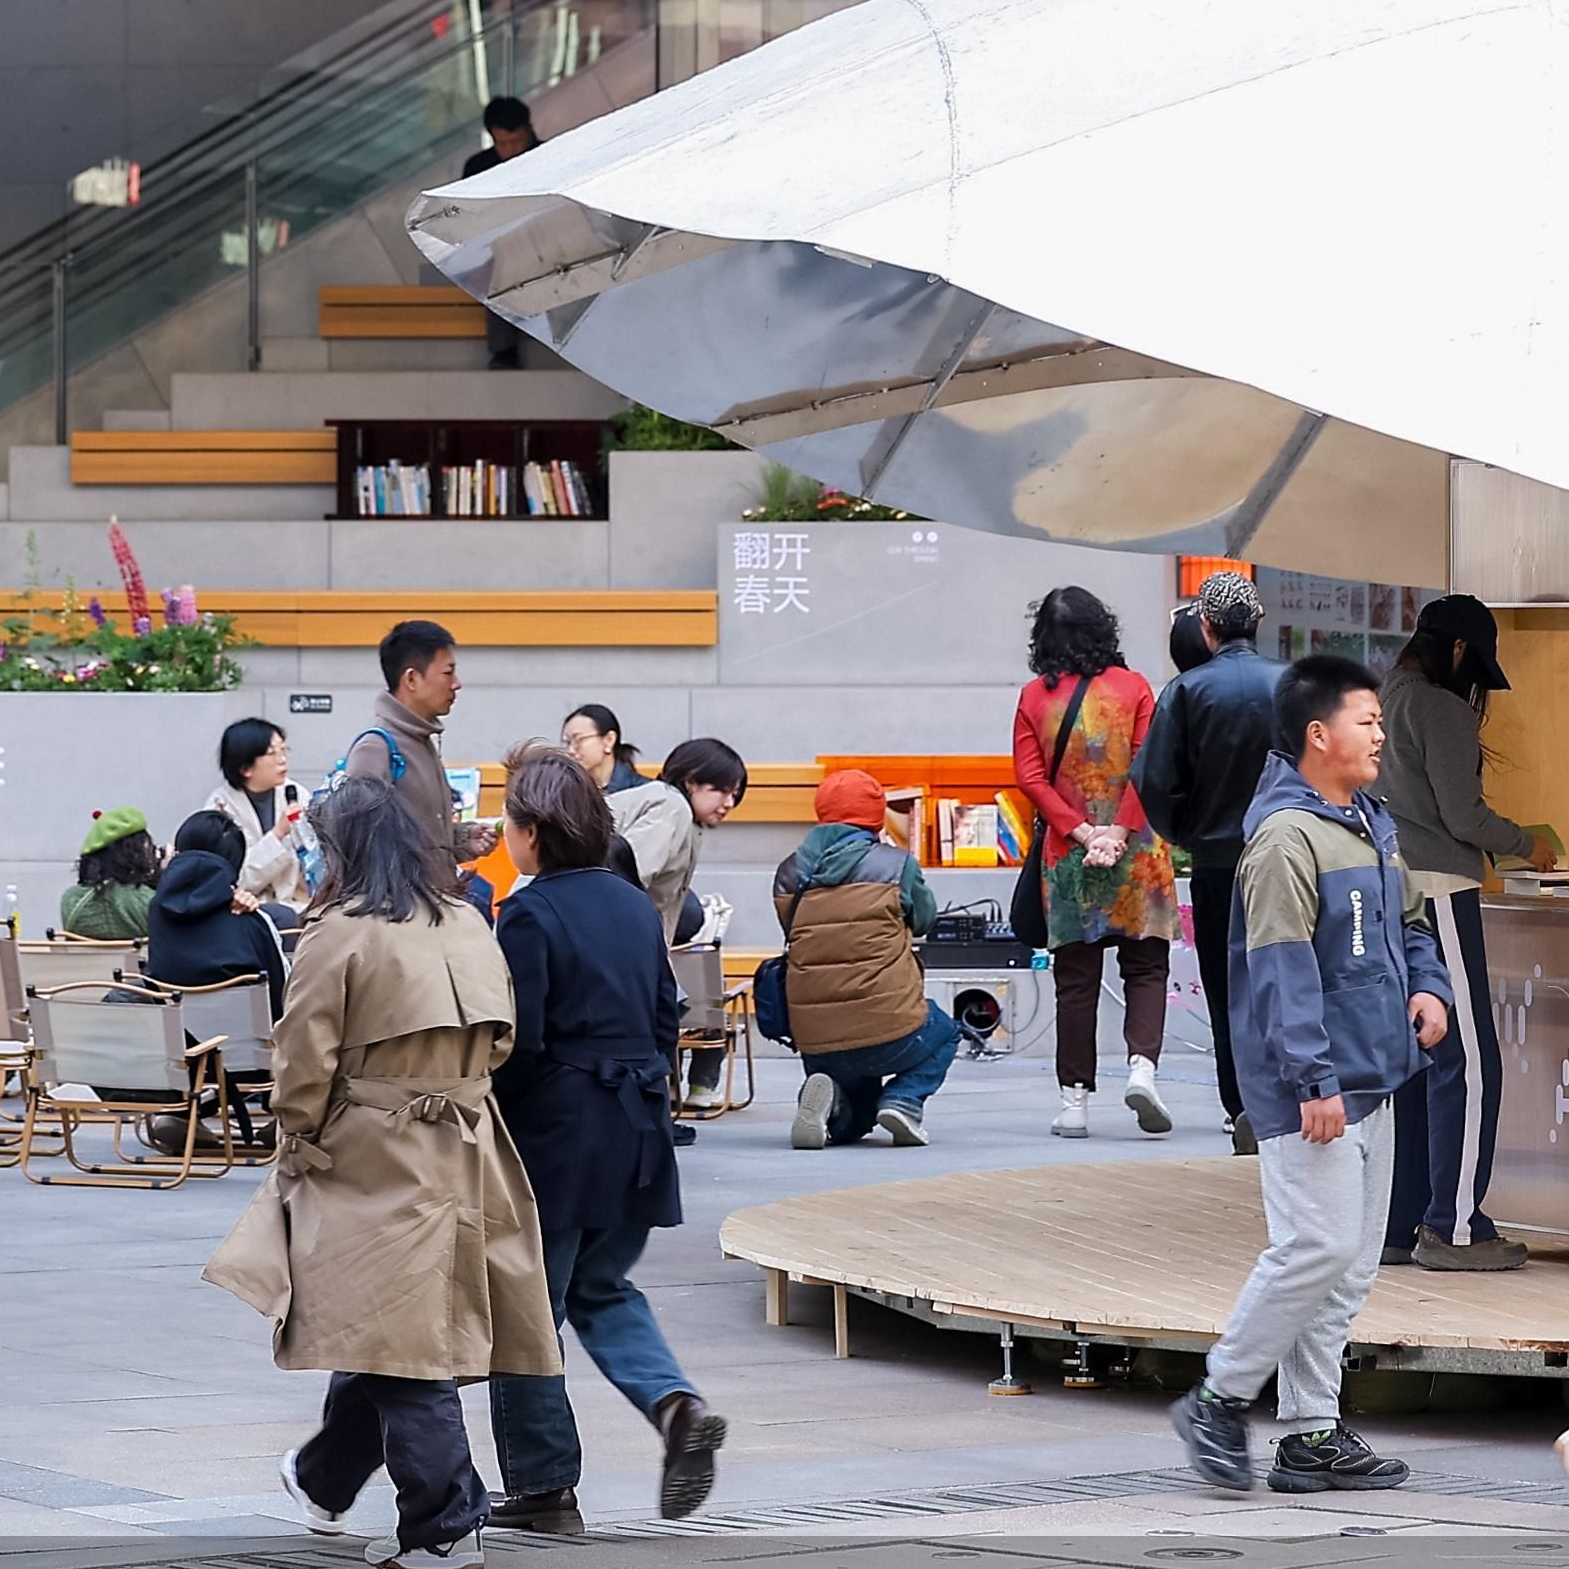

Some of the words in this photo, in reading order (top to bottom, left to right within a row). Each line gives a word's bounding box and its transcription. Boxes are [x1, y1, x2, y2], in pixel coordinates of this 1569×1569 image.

[733, 532, 811, 571] 翻开
[733, 574, 810, 614] 春天
[1349, 889, 1366, 957] CAMPING
